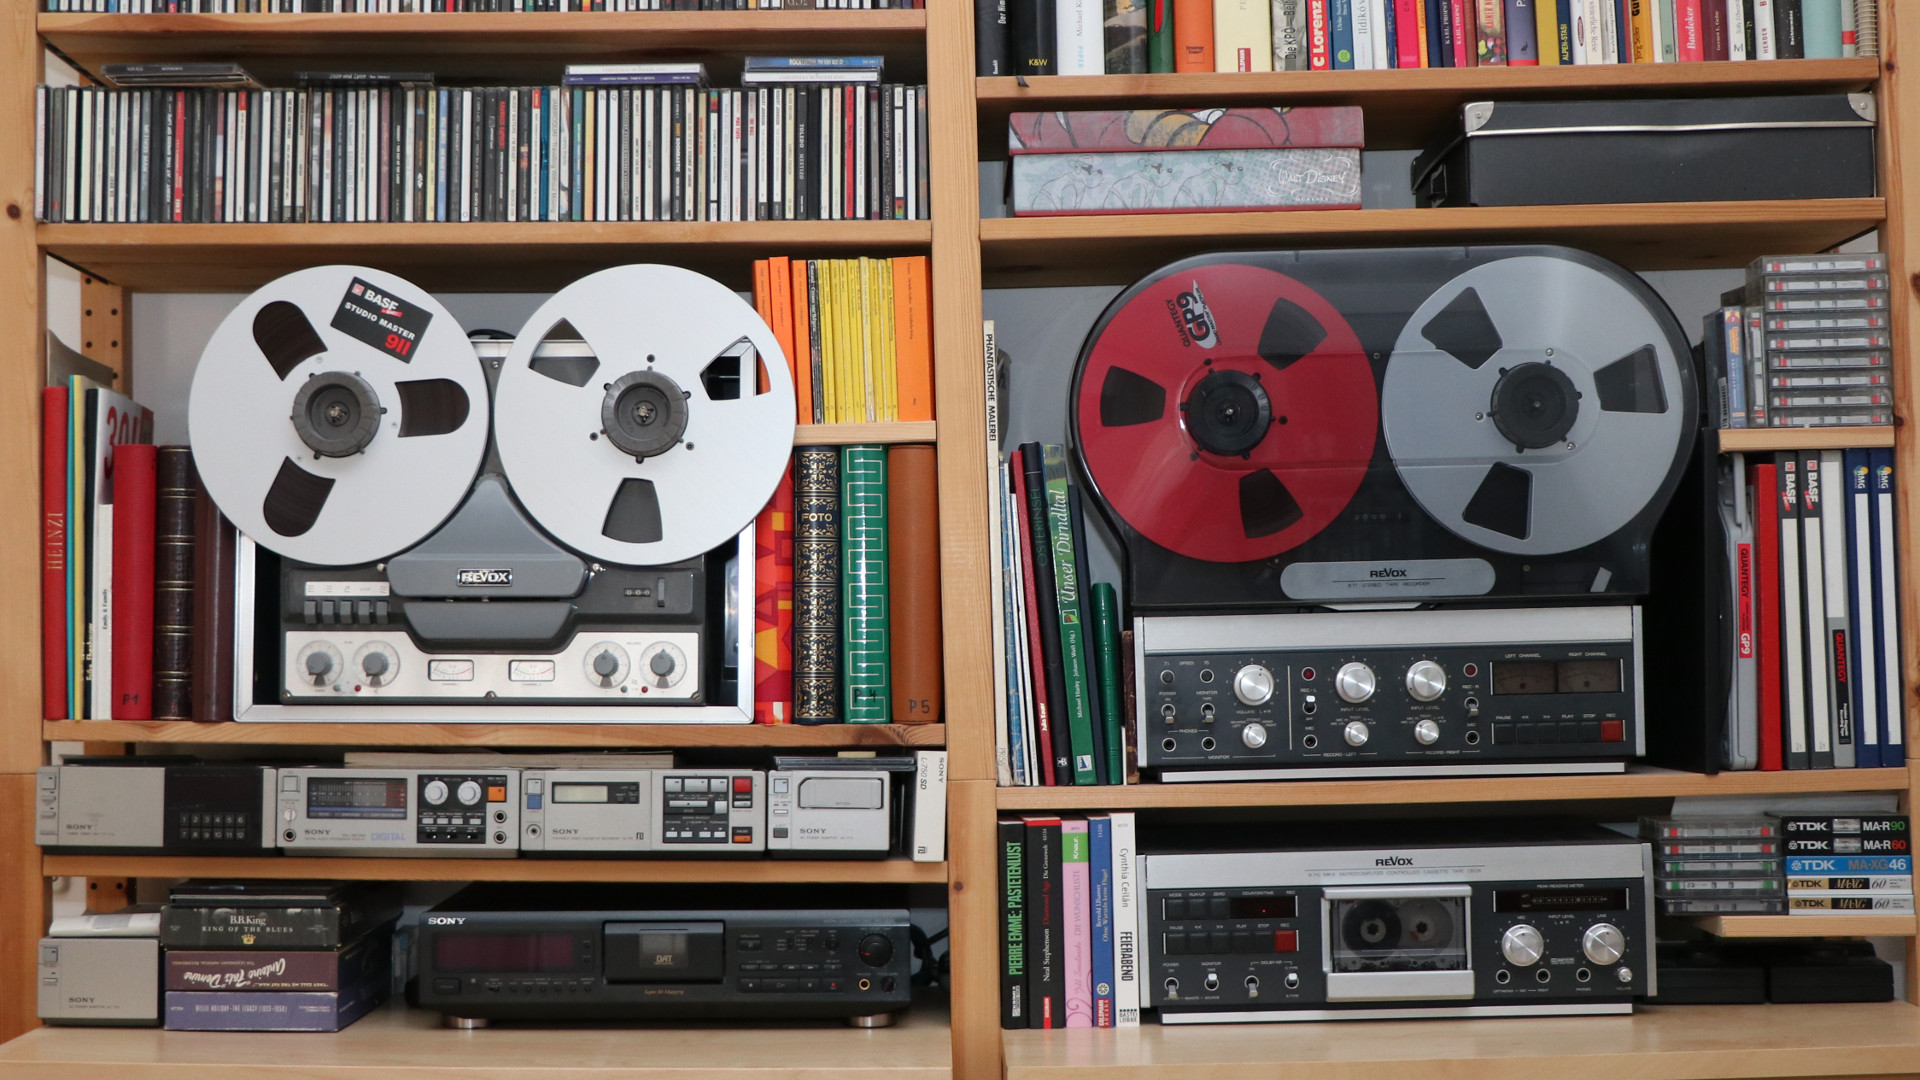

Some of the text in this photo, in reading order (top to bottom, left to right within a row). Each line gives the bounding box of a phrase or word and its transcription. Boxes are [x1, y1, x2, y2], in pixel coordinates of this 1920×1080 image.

[997, 13, 1007, 24] Der
[1357, 6, 1367, 35] Ildikó
[1442, 1, 1450, 25] PROPST
[1312, 0, 1325, 67] C Lorenz
[1685, 6, 1697, 49] Baedeker
[1560, 24, 1569, 61] ALPEN-STASI
[1590, 36, 1598, 53] Reise
[1761, 27, 1769, 54] HERDER
[1028, 58, 1048, 66] K&W
[1284, 47, 1297, 60] Die
[364, 289, 399, 311] BASF
[344, 301, 416, 341] STUDIO MASTER
[1165, 298, 1191, 347] QUANTEGY
[1176, 291, 1210, 342] GP9
[385, 333, 413, 356] 911
[986, 333, 997, 442] PHANTASTISCHE MALEREI
[1785, 473, 1796, 504] BASF
[1807, 472, 1818, 503] BASF
[1857, 470, 1865, 489] RMG
[1880, 470, 1889, 489] RMG
[801, 512, 833, 522] FOTO
[1030, 486, 1048, 566] OSTERINSEL
[46, 511, 64, 571] HEINZI
[1048, 489, 1077, 604] Unser Dirndltal
[1740, 548, 1751, 655] QUANTEGY GP9
[1072, 657, 1081, 677] Johann
[1835, 632, 1847, 683] QUANTEGY
[1075, 698, 1084, 718] Michael
[920, 757, 928, 790] L-750 SD
[66, 823, 93, 831] SONY
[371, 832, 406, 841] DIGITAL
[1796, 822, 1828, 831] TDK
[1797, 841, 1829, 850] TDK
[1801, 860, 1836, 870] TDK
[1119, 848, 1130, 908] Cynthia Ceilán
[1798, 880, 1822, 888] TDK
[1871, 879, 1888, 889] 60
[1006, 841, 1023, 976] PIERRE EMME: PASTETENLUST
[1072, 869, 1082, 936] DIE WUNSCHLISTE
[1801, 899, 1825, 907] TDK
[1874, 899, 1890, 909] 60
[428, 917, 467, 925] SONY
[656, 954, 673, 963] DAT
[1042, 928, 1051, 965] Stephenson
[1120, 931, 1134, 982] FEIERABEND
[183, 971, 222, 988] Domino
[1043, 966, 1051, 982] Neal
